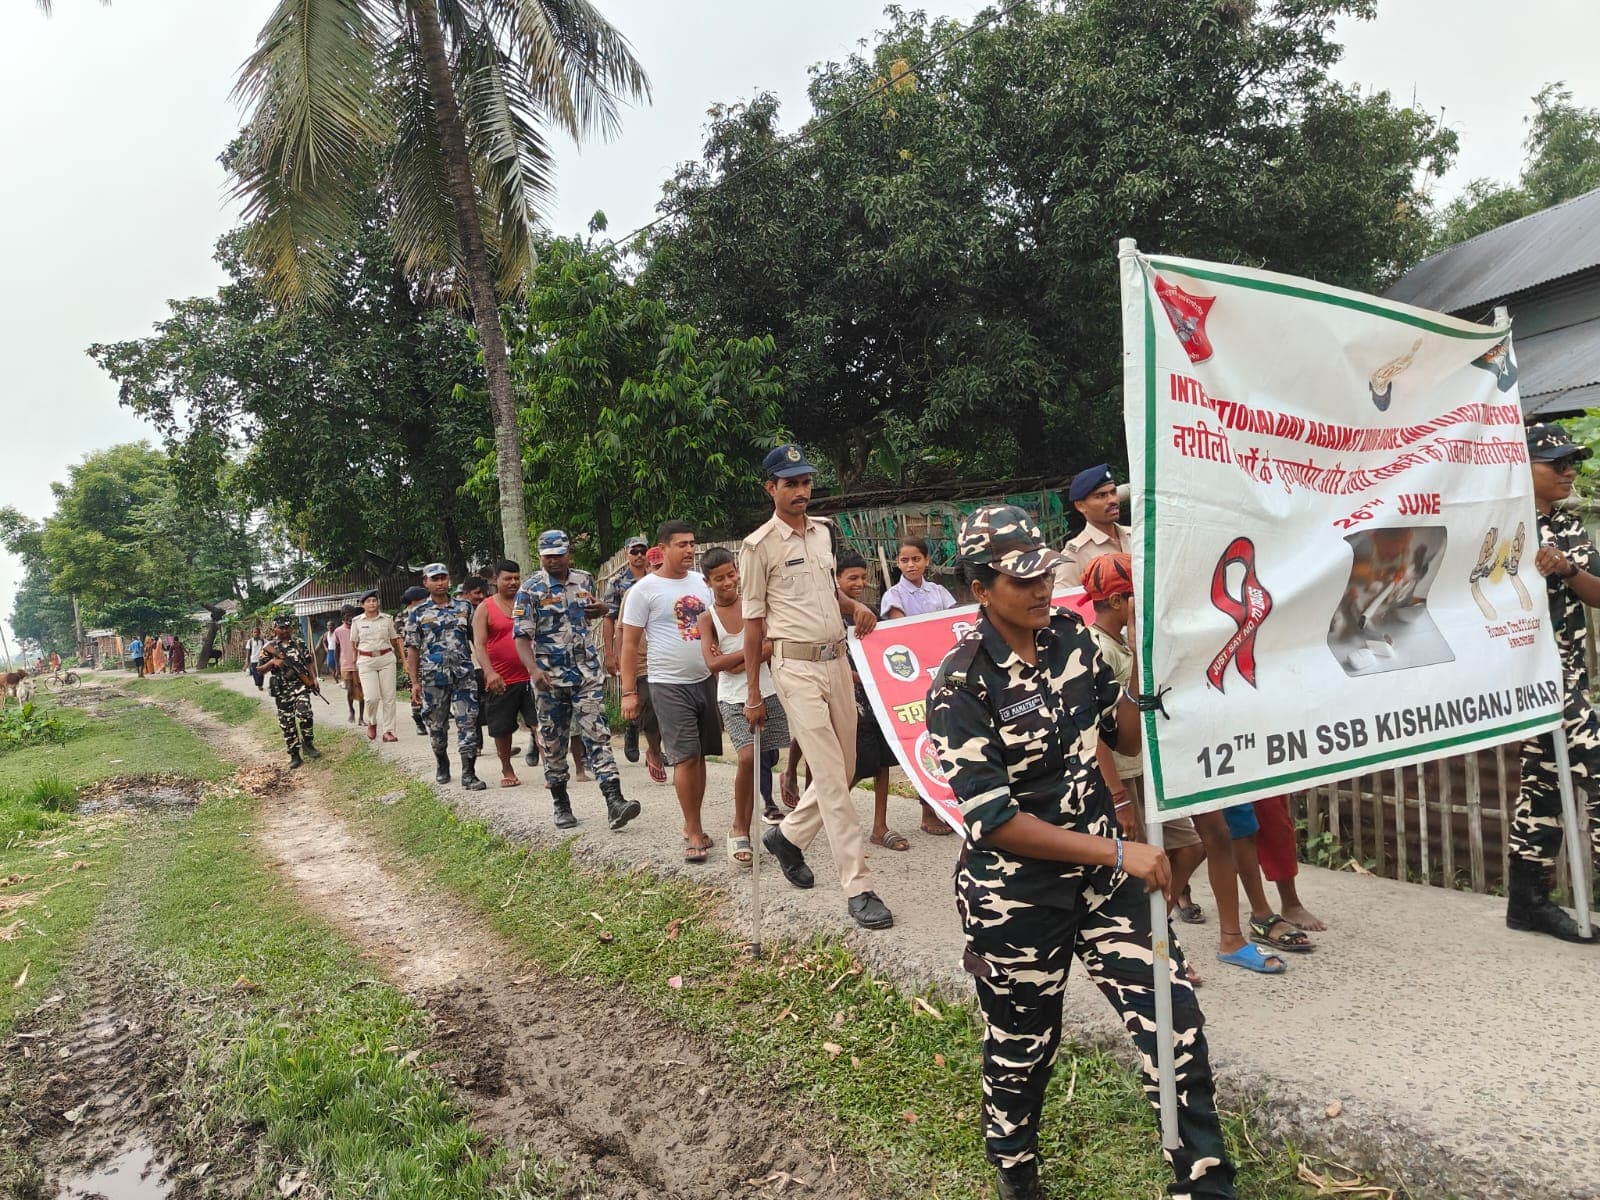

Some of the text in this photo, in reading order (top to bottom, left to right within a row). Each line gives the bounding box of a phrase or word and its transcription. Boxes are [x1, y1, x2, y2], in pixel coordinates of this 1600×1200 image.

[1172, 420, 1232, 464] नशीली
[1275, 411, 1306, 441] DAY
[1400, 424, 1438, 445] AND
[1397, 493, 1441, 516] JUNE
[1212, 652, 1229, 676] JUST
[1228, 634, 1243, 653] SAY
[1243, 620, 1255, 637] NO
[1196, 680, 1561, 779] 12TH BN SSB KISHANGANJ BIHAR
